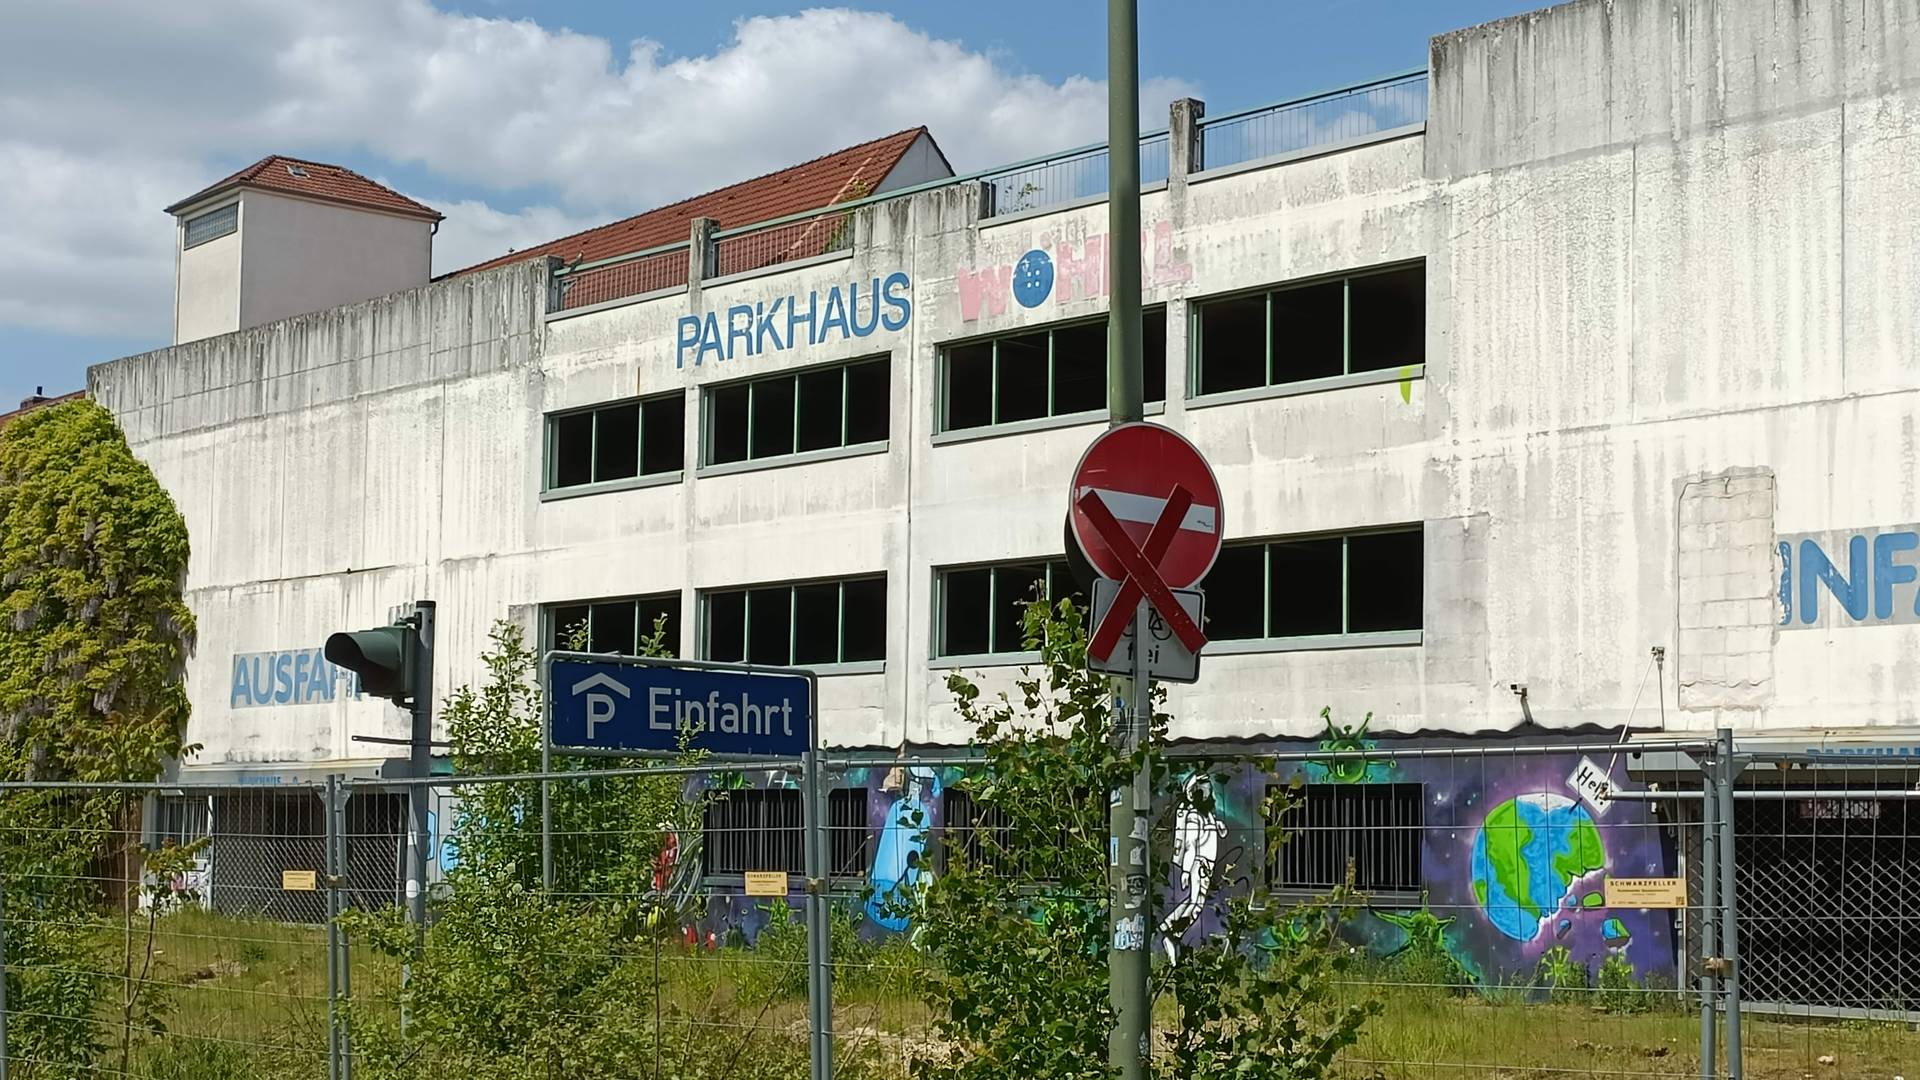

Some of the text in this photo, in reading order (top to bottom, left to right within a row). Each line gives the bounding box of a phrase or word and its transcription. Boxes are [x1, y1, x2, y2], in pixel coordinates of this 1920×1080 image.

[676, 271, 912, 369] PARKHAUS
[1127, 641, 1160, 664] fi
[586, 686, 793, 740] P Einfahrt
